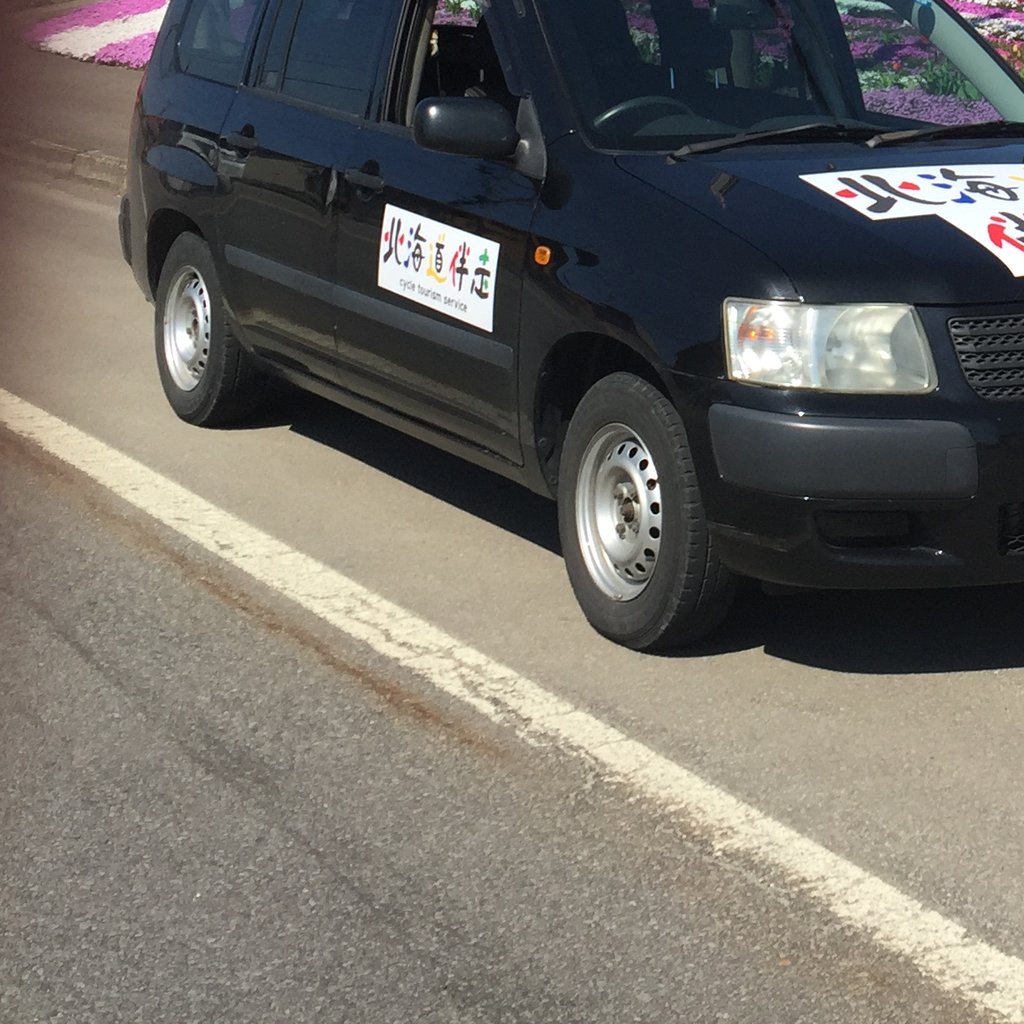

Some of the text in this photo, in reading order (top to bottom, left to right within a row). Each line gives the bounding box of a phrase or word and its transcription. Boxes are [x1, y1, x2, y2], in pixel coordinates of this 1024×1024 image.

[399, 278, 468, 313] cycle tourism service
